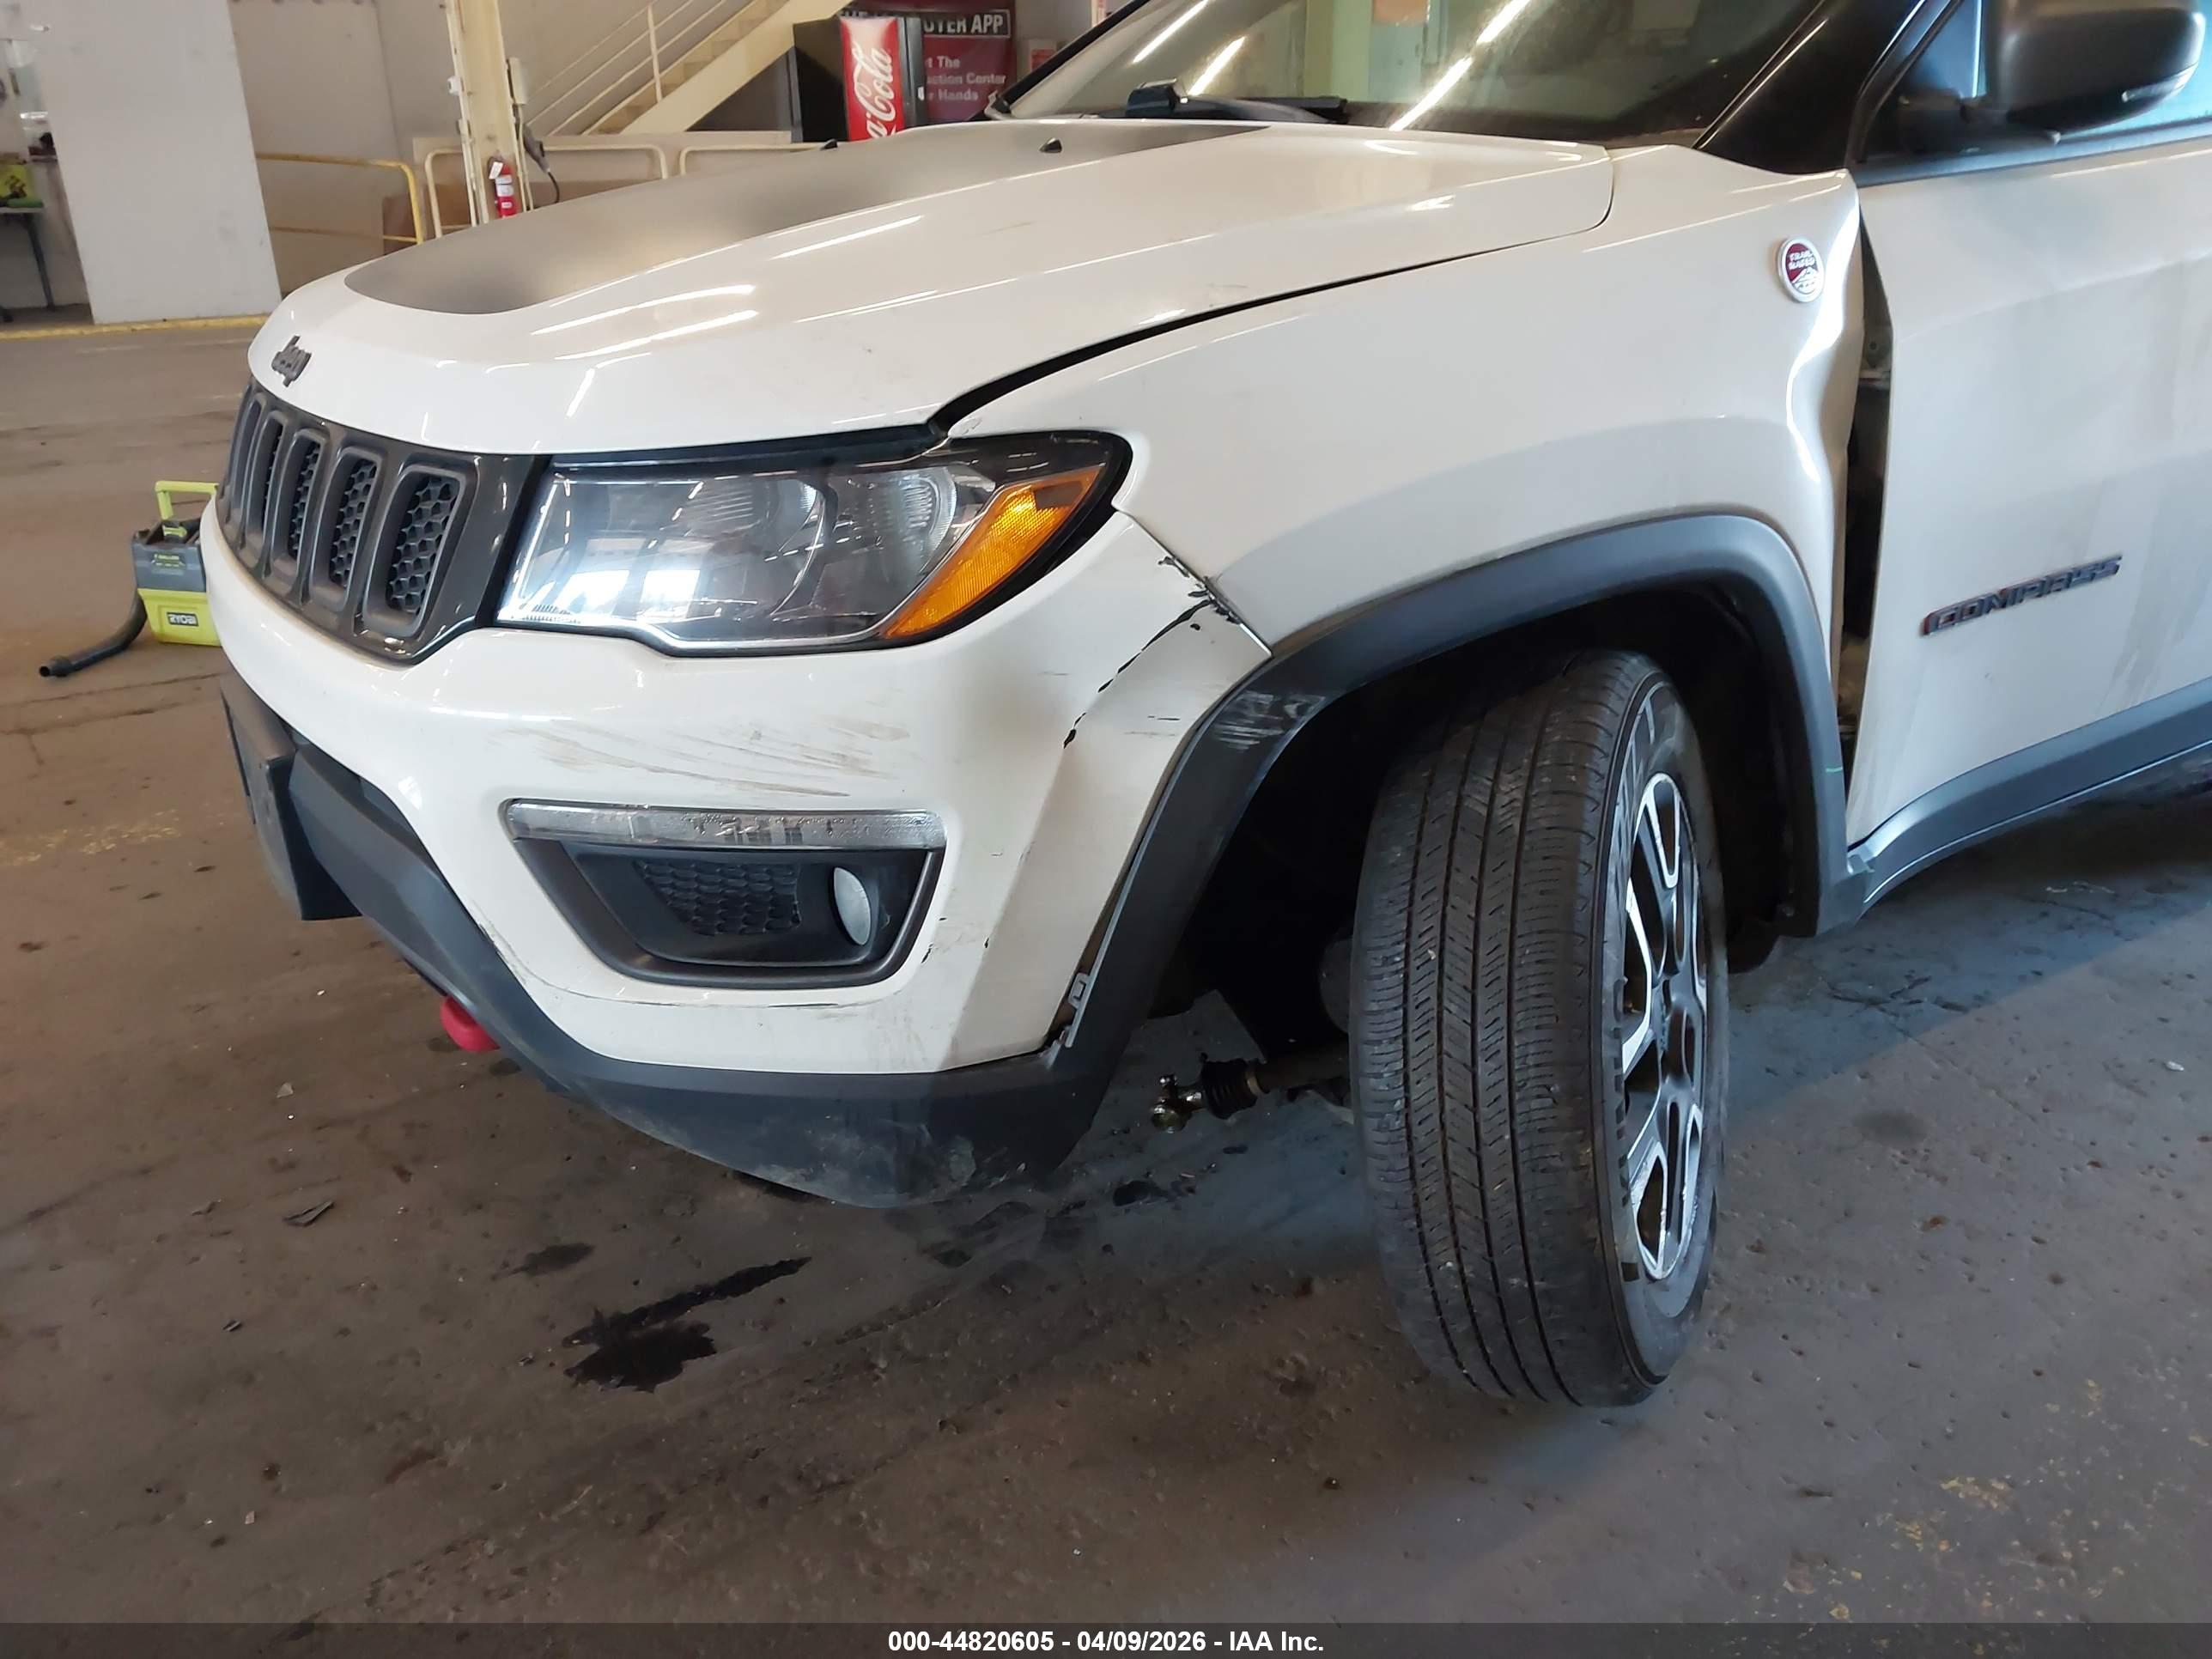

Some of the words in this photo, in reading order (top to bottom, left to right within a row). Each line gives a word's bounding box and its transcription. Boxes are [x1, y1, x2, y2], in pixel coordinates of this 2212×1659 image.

[923, 20, 967, 33] UYER
[970, 14, 1004, 33] APP
[936, 56, 960, 68] The
[927, 73, 963, 84] uction
[965, 72, 1006, 84] Center
[938, 88, 978, 100] Hands
[1920, 555, 2123, 635] COMPASS
